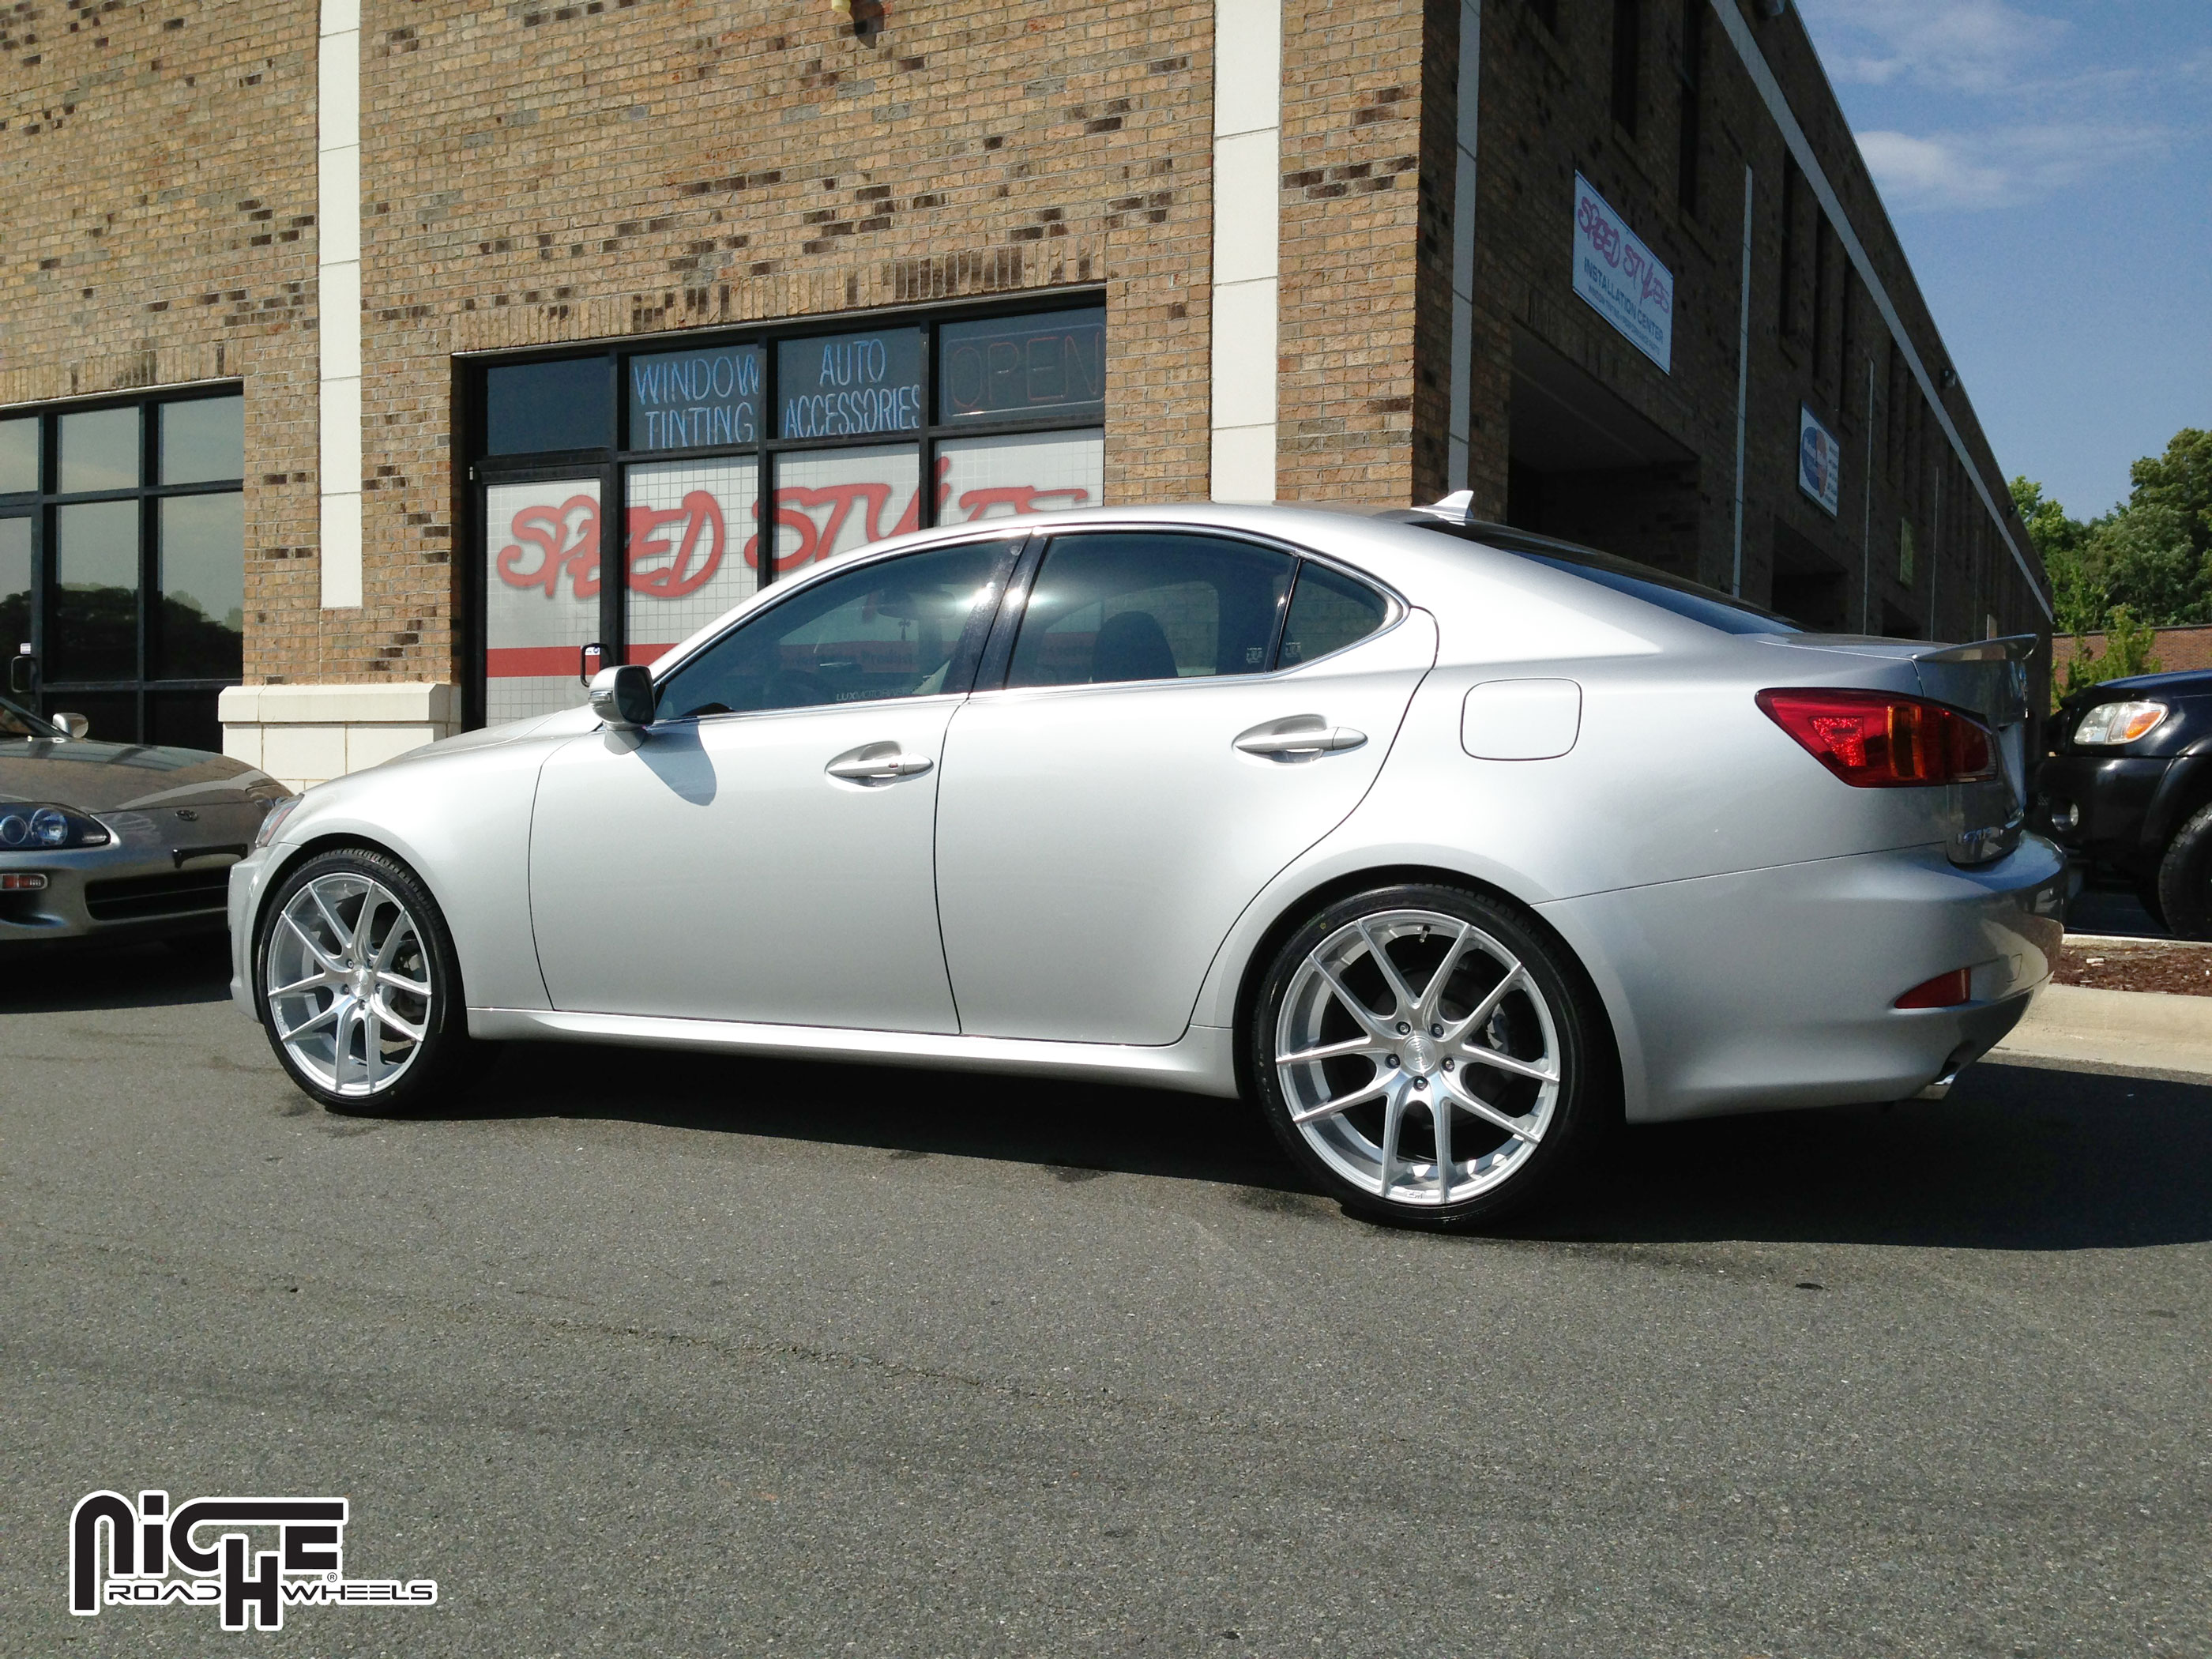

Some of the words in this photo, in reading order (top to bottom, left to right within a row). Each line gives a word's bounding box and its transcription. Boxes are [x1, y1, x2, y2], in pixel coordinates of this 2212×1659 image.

[1578, 196, 1620, 269] SPEED
[1623, 243, 1670, 314] STYLES
[1584, 256, 1637, 320] INSTALLATION
[1637, 308, 1664, 344] CENTER
[634, 354, 759, 406] WINDOW
[819, 340, 886, 387] AUTO
[950, 330, 1100, 408] OPEN
[645, 401, 754, 450] TINTING
[784, 384, 920, 439] ACCESSORIES
